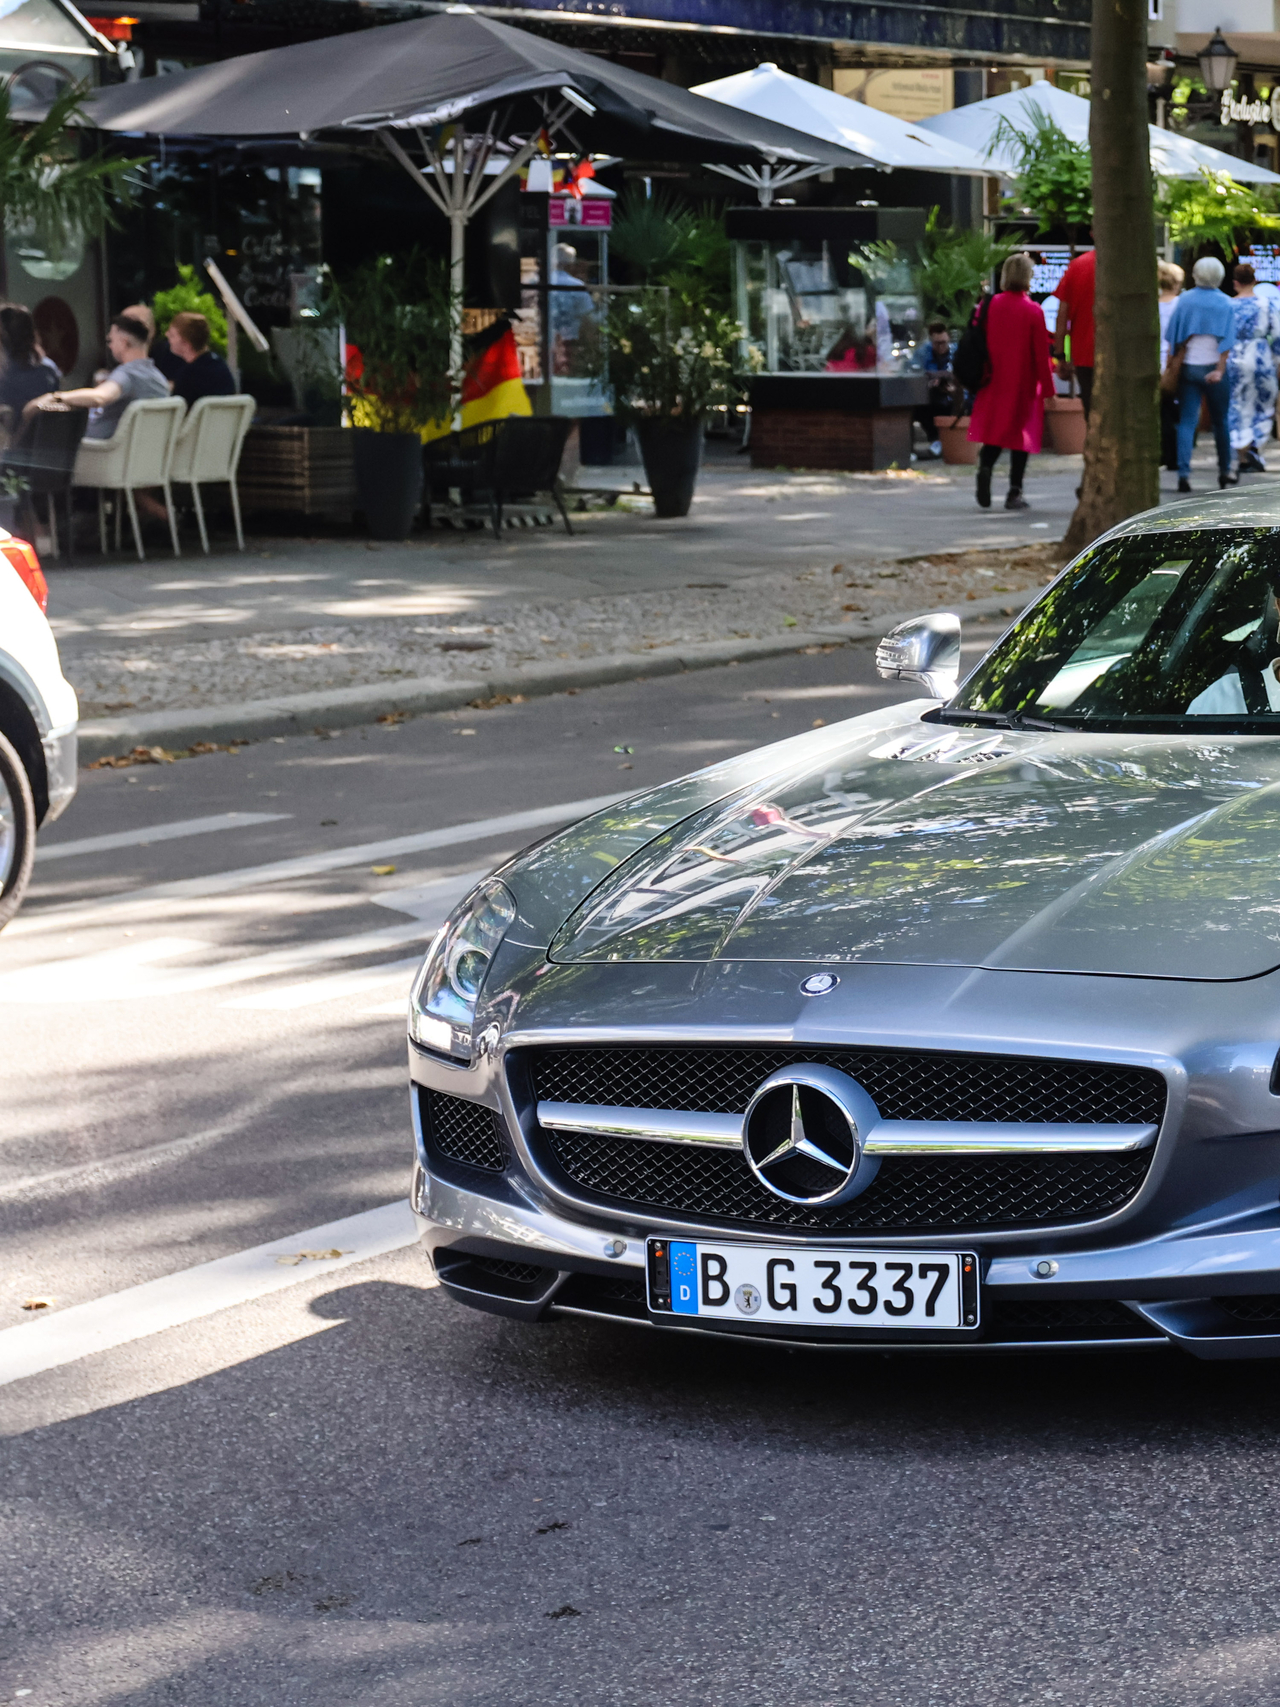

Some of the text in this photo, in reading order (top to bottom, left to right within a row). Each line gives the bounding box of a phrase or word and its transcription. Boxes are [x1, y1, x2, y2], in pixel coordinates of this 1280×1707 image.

[680, 1285, 690, 1301] D
[701, 1253, 950, 1317] B G 3337
